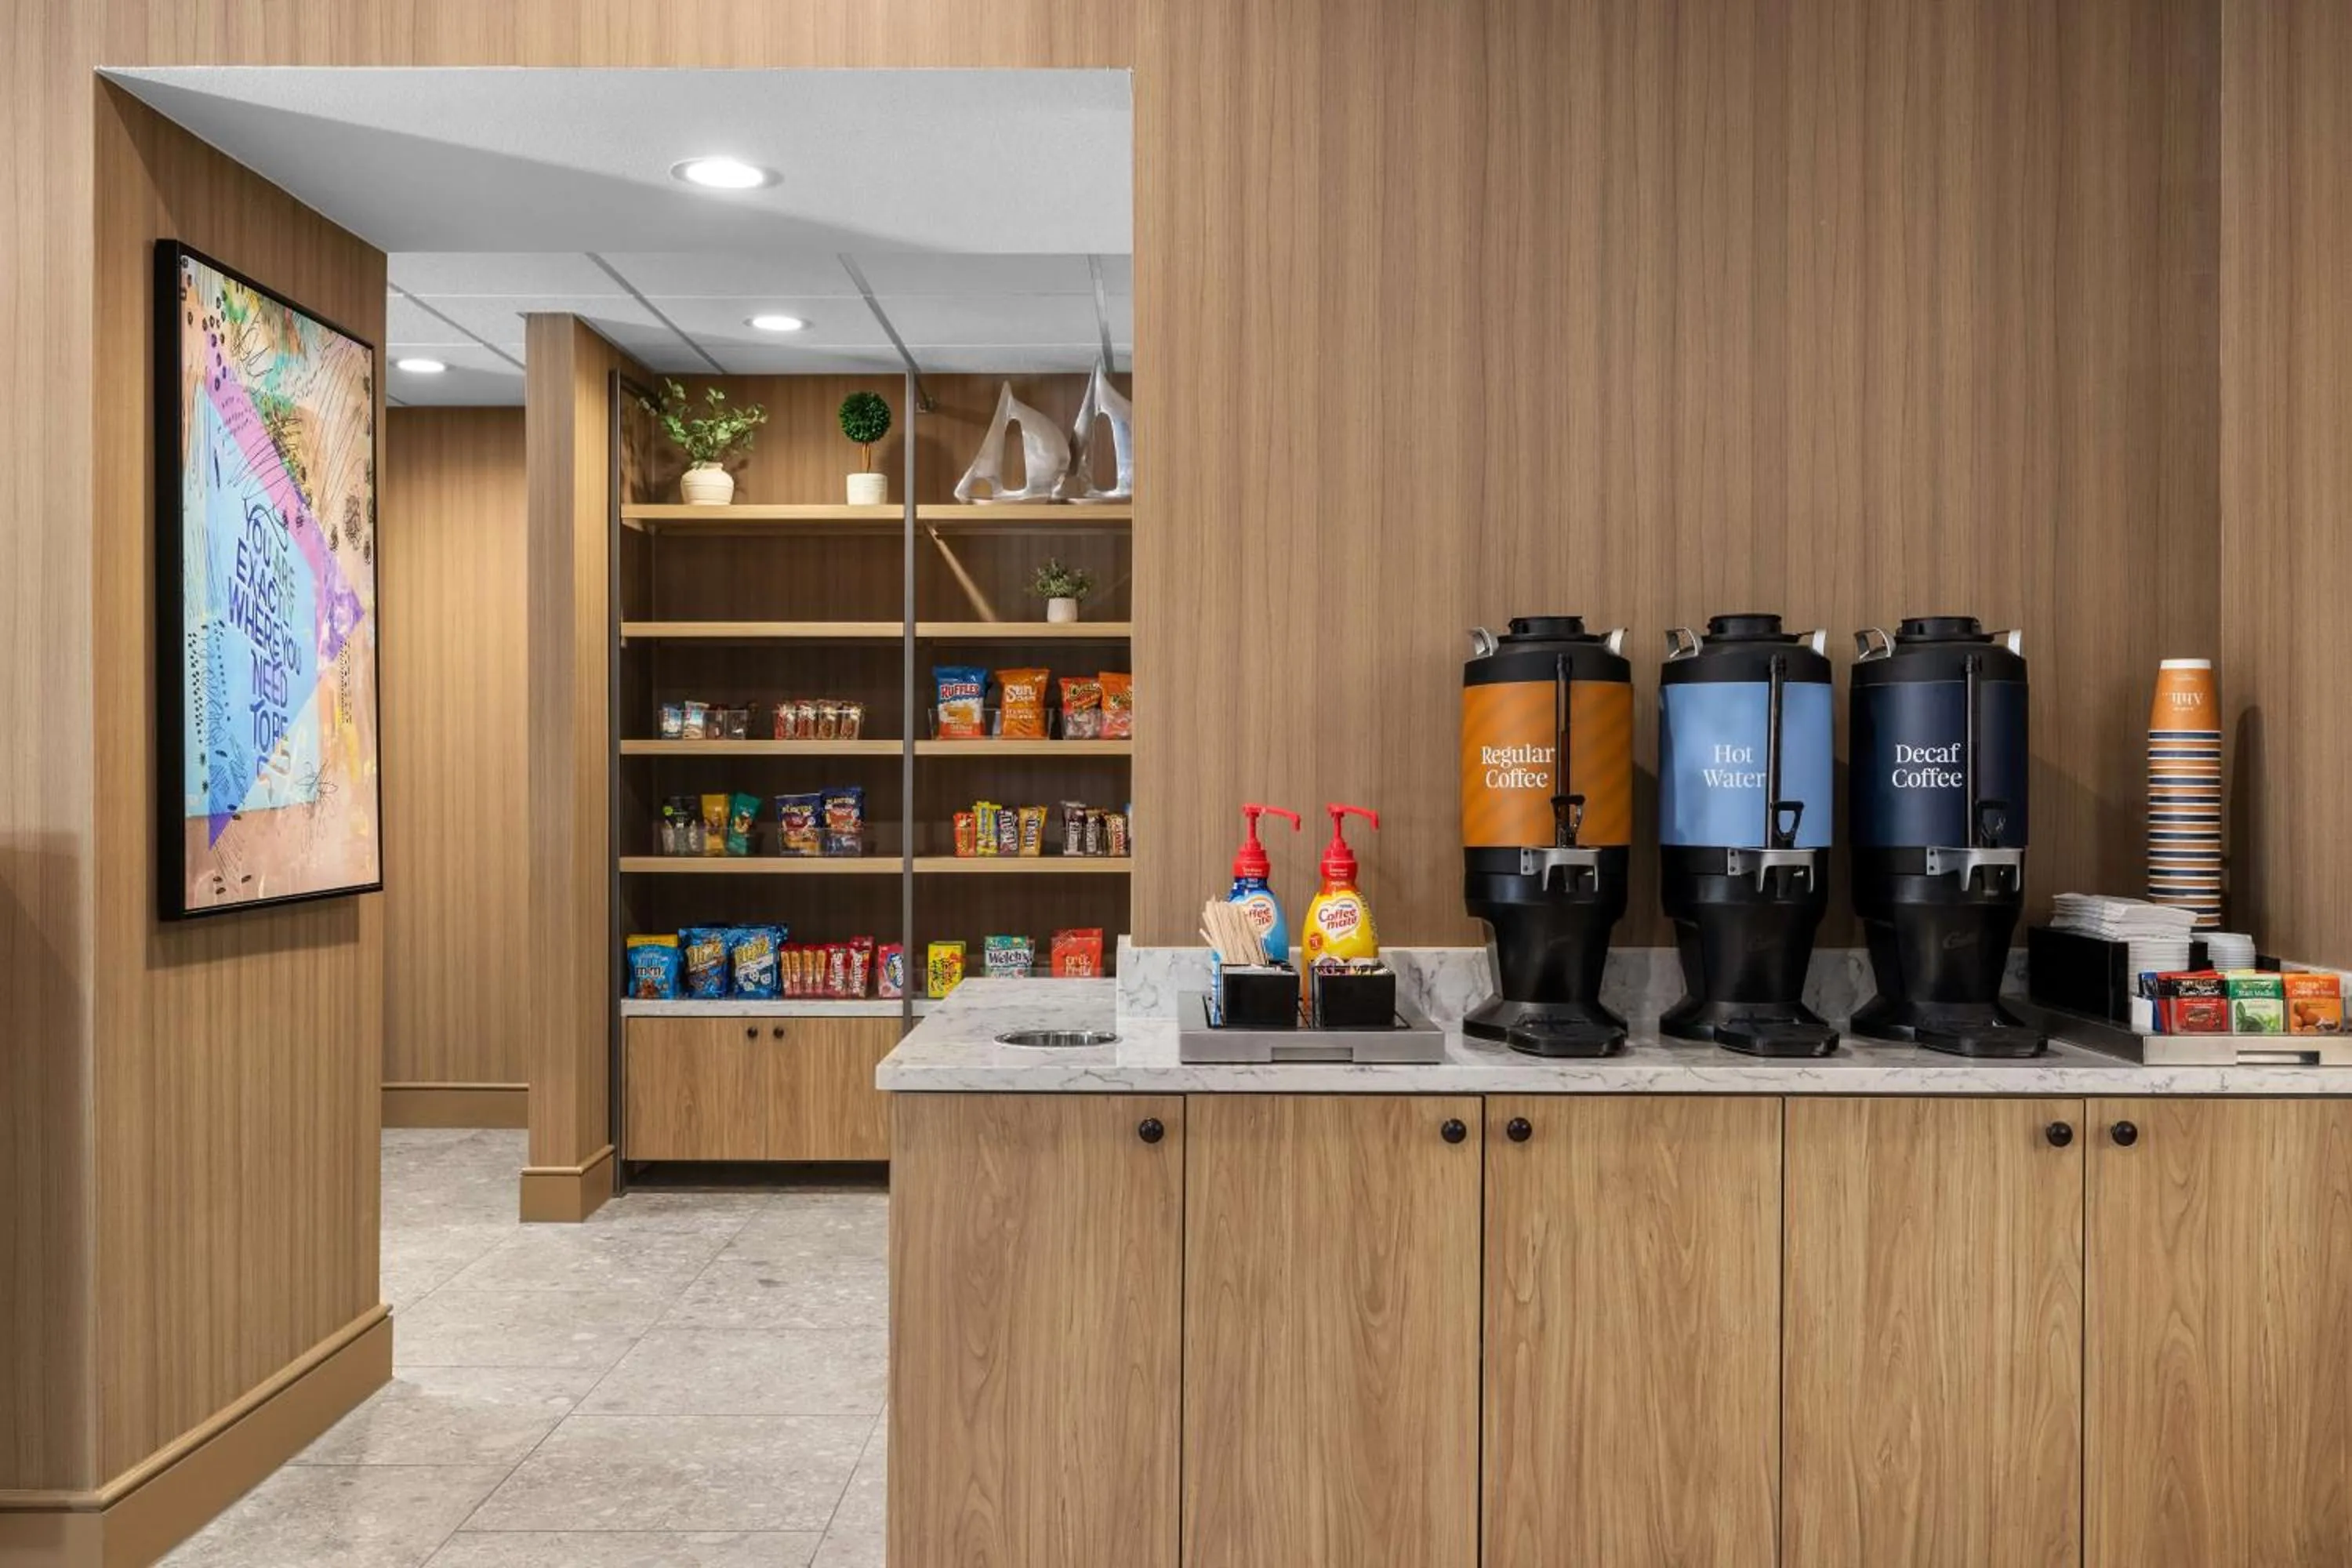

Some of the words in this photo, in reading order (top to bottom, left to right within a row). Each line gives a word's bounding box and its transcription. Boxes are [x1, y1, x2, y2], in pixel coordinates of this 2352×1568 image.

[228, 576, 280, 662] WHERE
[250, 648, 288, 708] NEED
[940, 683, 980, 699] RUFFLES
[249, 699, 271, 753] TO
[1480, 743, 1556, 768] Regular
[1714, 744, 1754, 764] Hot
[1895, 742, 1962, 763] Decaf
[1486, 768, 1549, 789] Coffee
[1703, 769, 1766, 789] Water
[1891, 768, 1963, 788] Coffee
[1319, 908, 1357, 923] Coffee
[1327, 916, 1357, 931] mate
